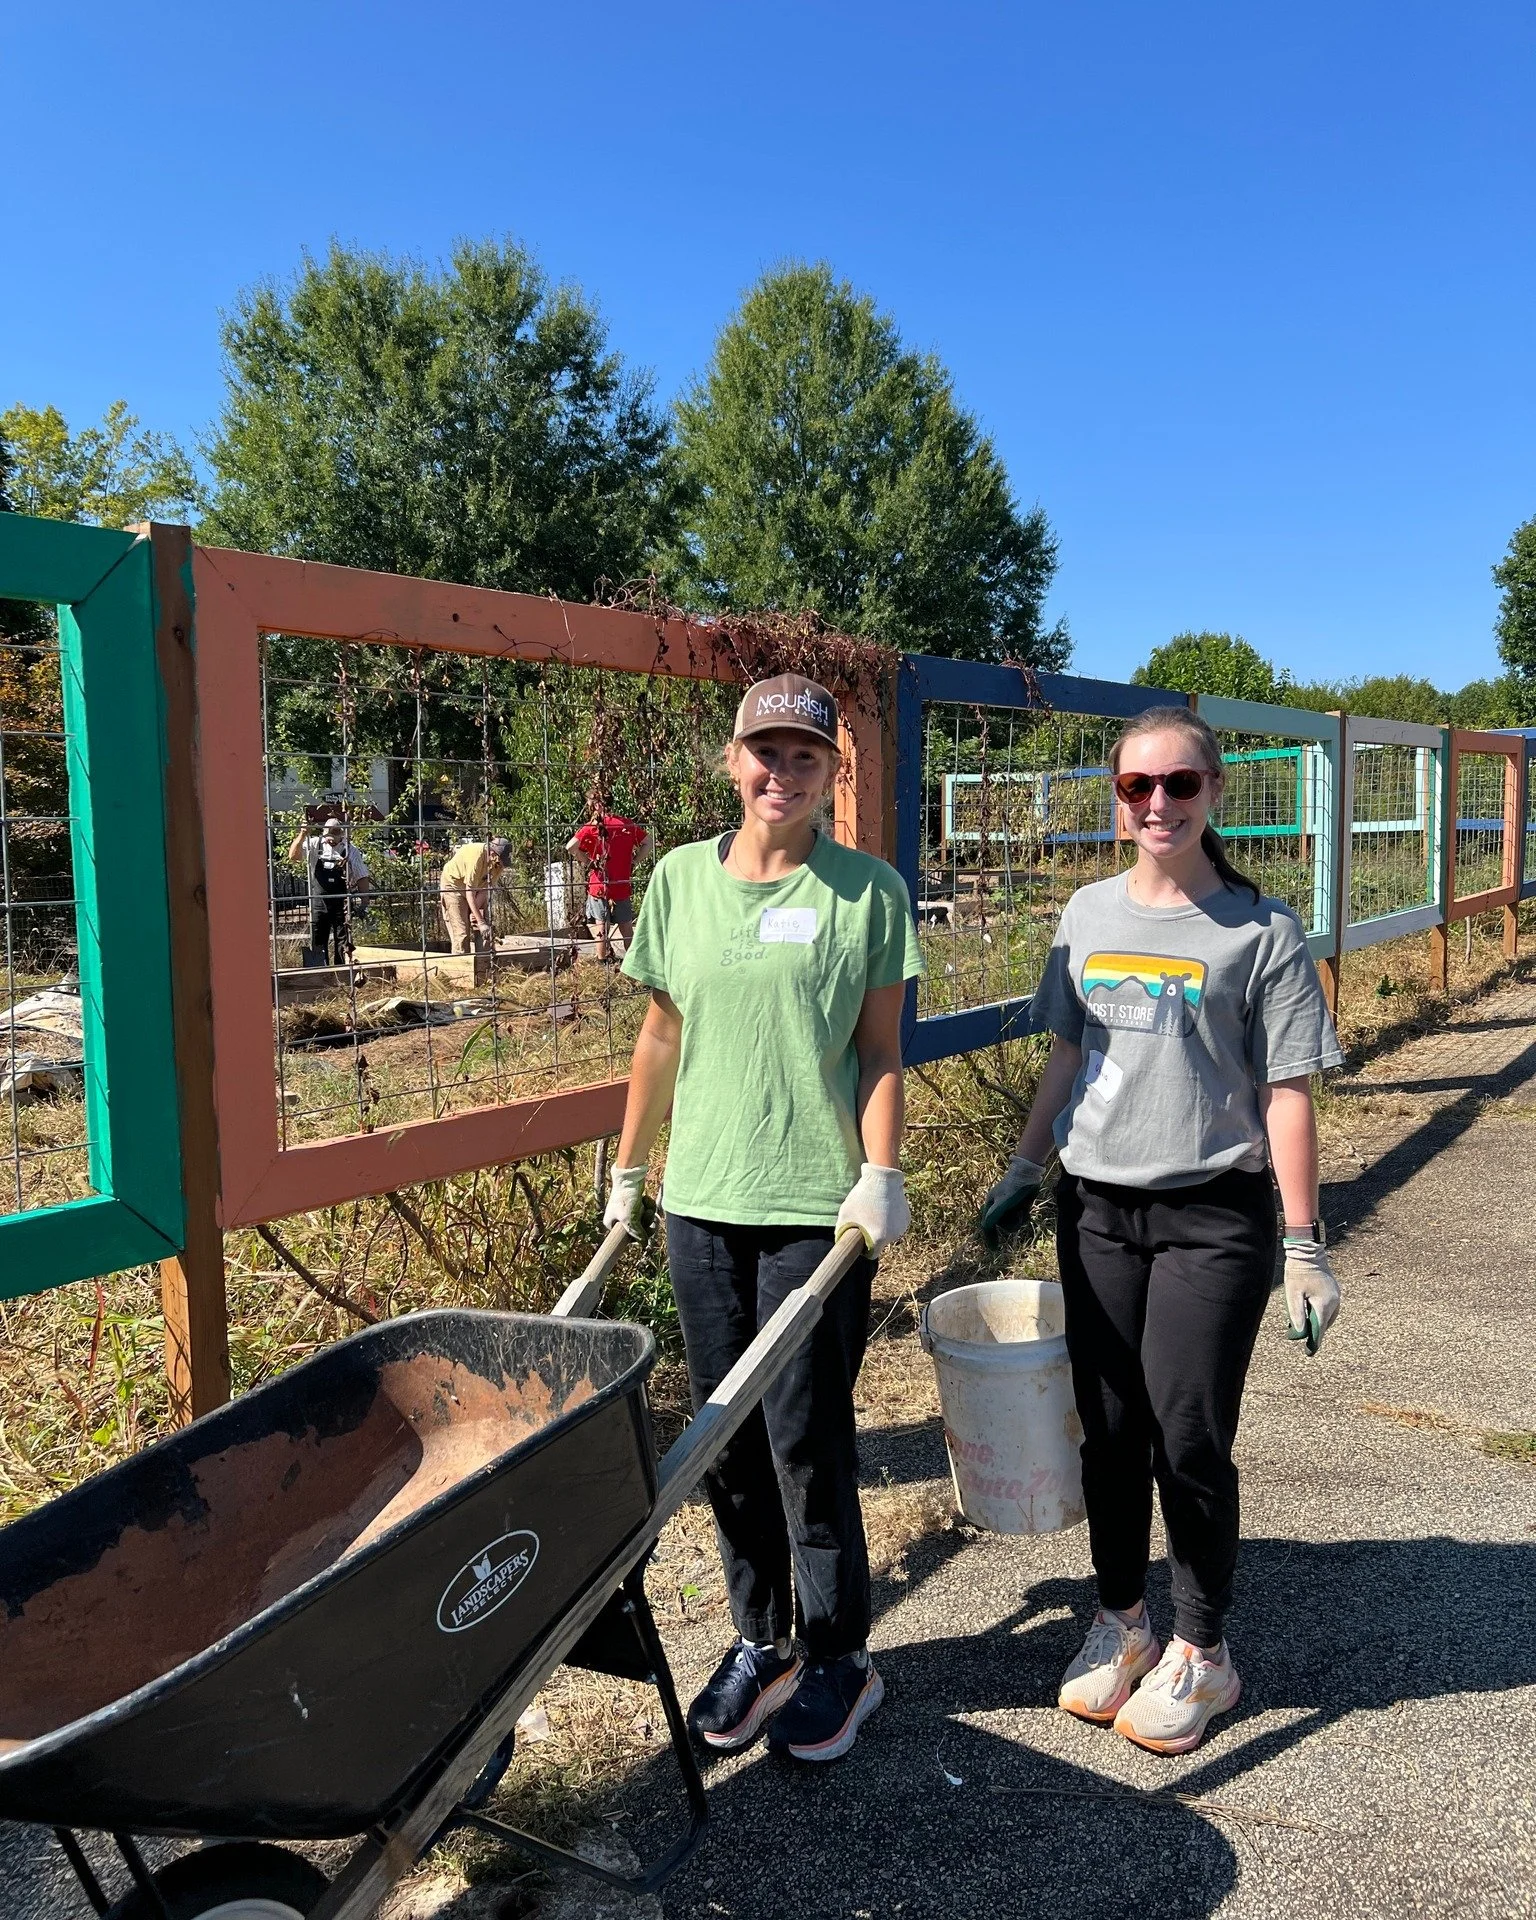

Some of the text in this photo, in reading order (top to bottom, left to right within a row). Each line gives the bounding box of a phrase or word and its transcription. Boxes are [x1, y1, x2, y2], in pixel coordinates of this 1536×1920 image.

[757, 692, 828, 720] NOURISH
[756, 708, 829, 727] HAIR SALON
[730, 923, 760, 940] Life
[767, 917, 800, 929] Katie
[740, 940, 754, 950] is
[1118, 1004, 1154, 1022] STORE
[472, 1574, 514, 1613] SELECT
